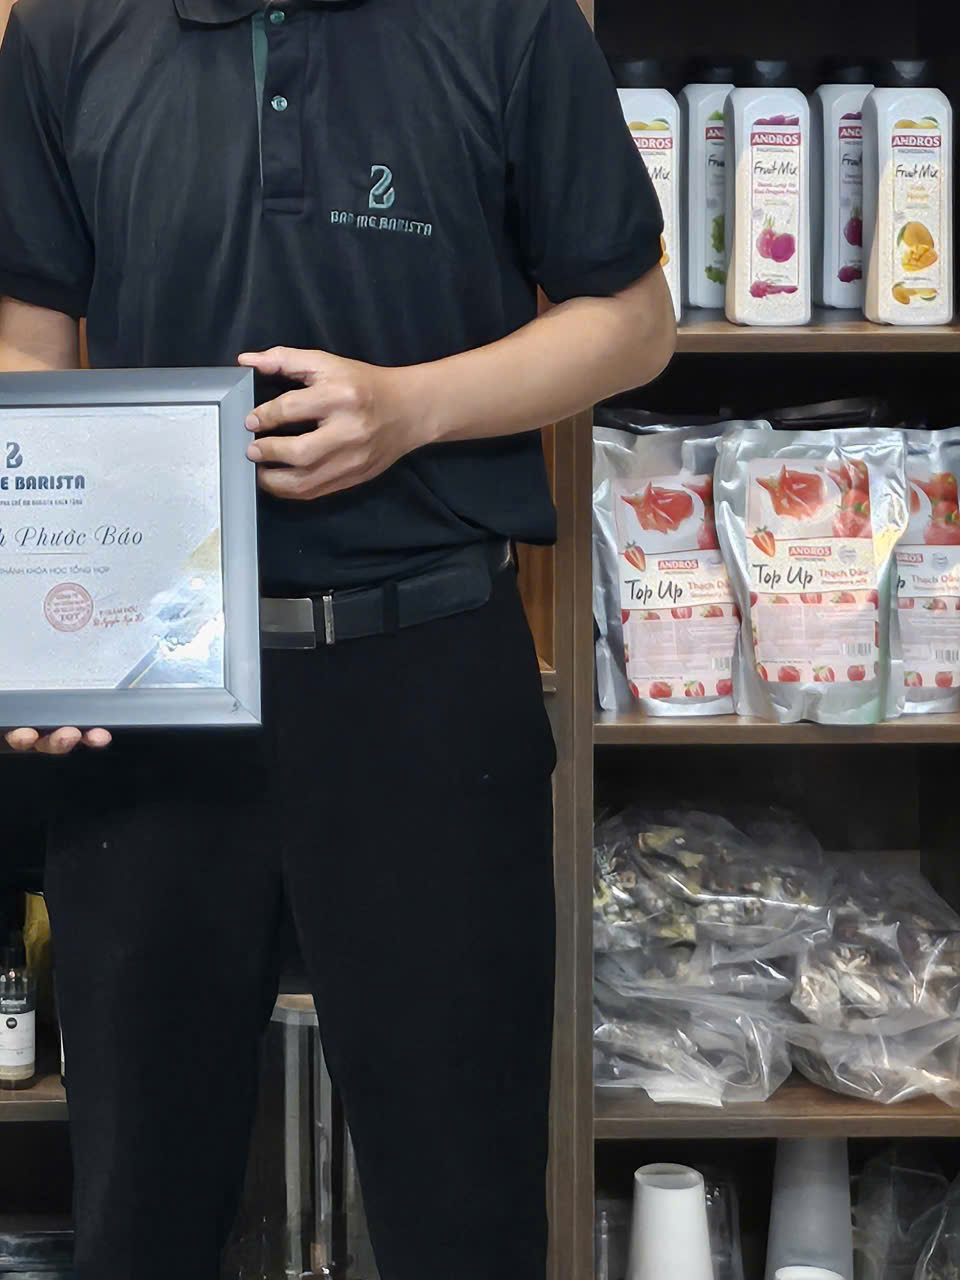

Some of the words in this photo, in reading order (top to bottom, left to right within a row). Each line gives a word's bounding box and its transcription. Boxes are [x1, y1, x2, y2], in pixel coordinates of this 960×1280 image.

[633, 138, 672, 148] NDROS
[752, 134, 799, 145] ANDROS
[892, 136, 941, 147] ANDROS
[379, 217, 433, 236] BARISTA
[14, 474, 86, 490] BARISTA
[14, 524, 87, 547] Phước
[790, 547, 831, 556] ANDROS
[659, 560, 698, 569] ANDROS
[752, 563, 782, 589] Top
[786, 565, 814, 589] Up
[624, 579, 653, 605] Top
[657, 580, 684, 604] Up
